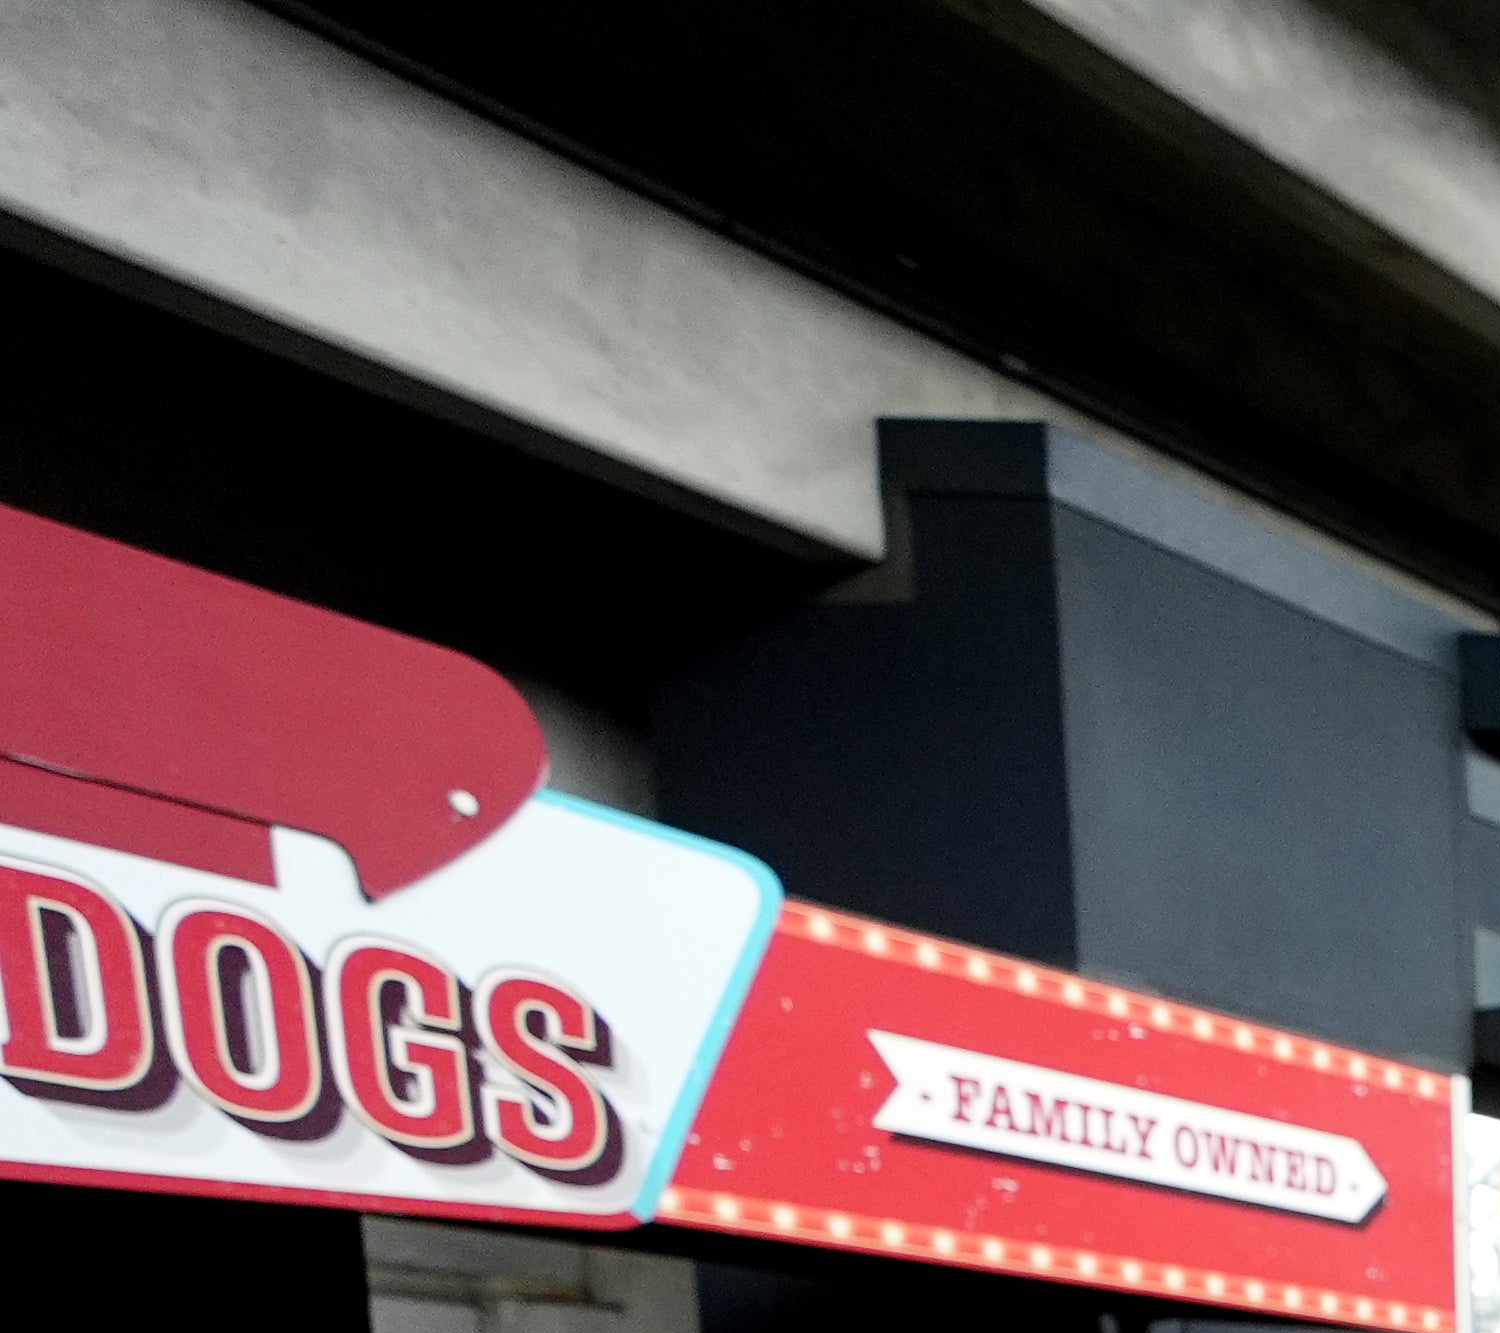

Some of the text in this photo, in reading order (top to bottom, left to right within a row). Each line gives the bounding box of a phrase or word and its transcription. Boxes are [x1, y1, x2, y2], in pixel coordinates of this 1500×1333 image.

[0, 858, 612, 1178] DOGS
[950, 1074, 1337, 1197] FAMILY OWNED
